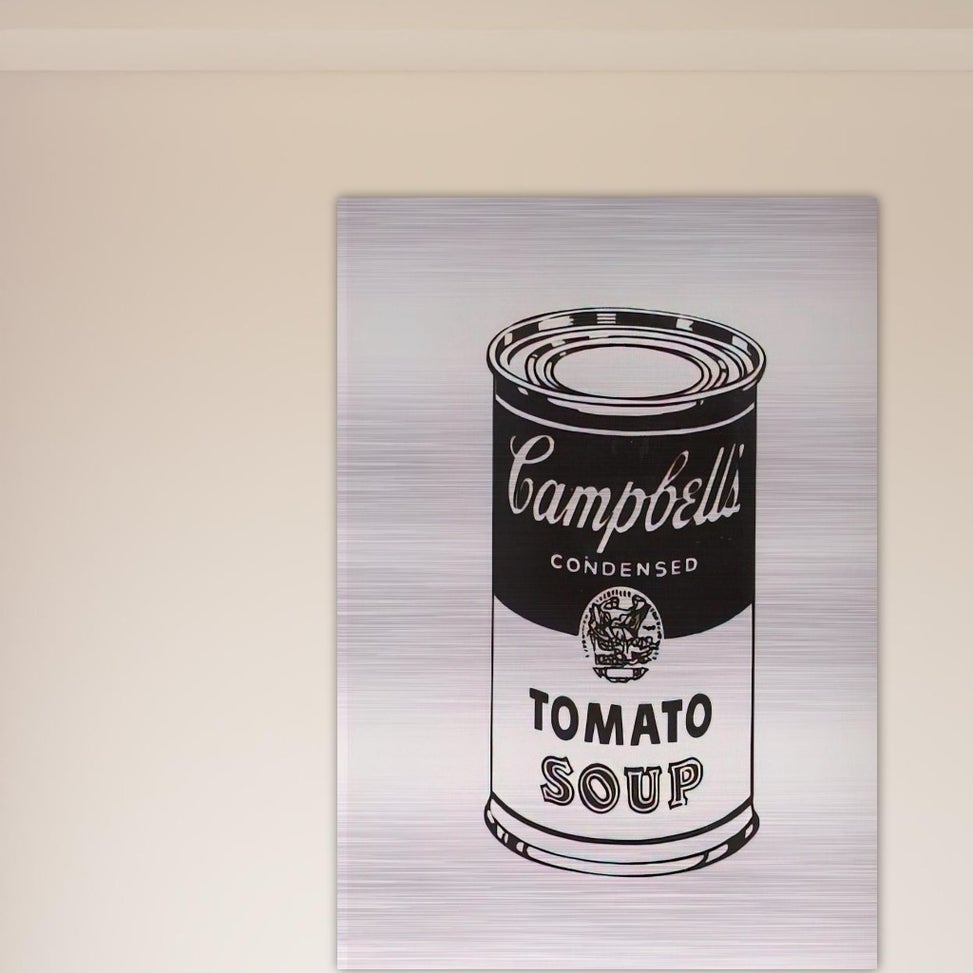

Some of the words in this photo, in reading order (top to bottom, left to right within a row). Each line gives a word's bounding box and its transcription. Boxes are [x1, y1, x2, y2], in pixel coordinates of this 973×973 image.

[508, 434, 745, 553] Campbell's
[550, 553, 698, 578] CONDENSED
[529, 688, 713, 746] TOMATO
[540, 756, 704, 814] SOUP
